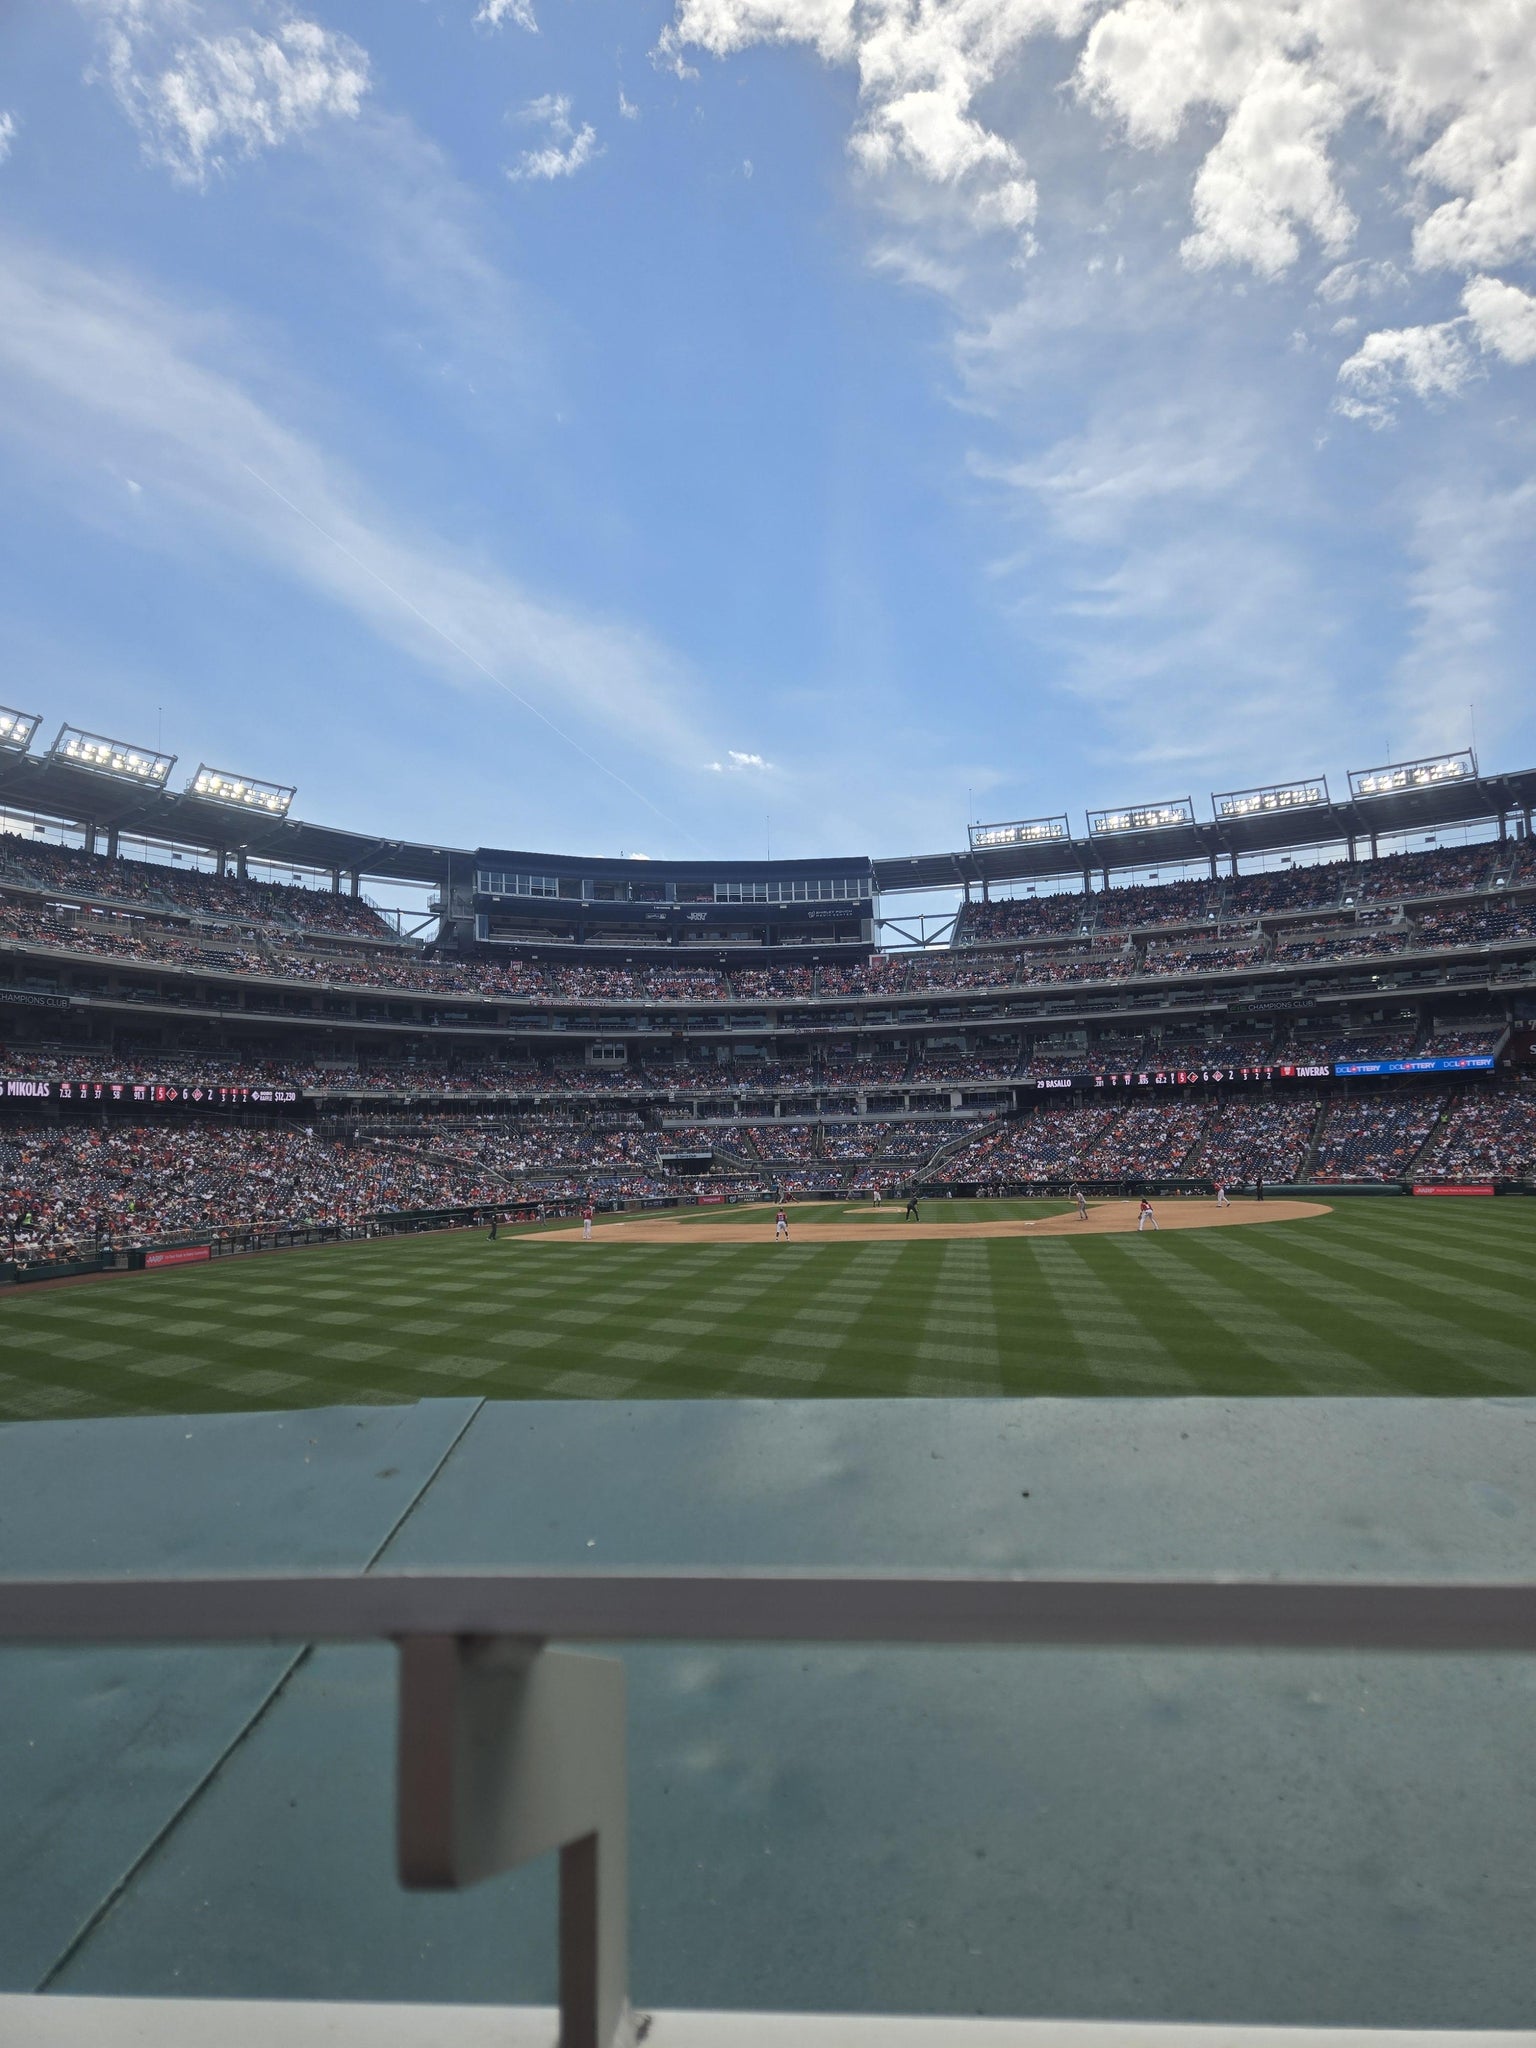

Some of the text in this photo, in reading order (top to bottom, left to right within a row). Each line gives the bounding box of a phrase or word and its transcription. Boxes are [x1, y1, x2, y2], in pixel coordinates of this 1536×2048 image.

[46, 998, 68, 1007] CLUB
[1248, 1001, 1293, 1011] CHAMPIONS
[1293, 999, 1314, 1008] CLUB
[1203, 1071, 1209, 1081] 6
[1228, 1070, 1234, 1080] 2
[1296, 1066, 1329, 1077] TAVERAS
[7, 1081, 50, 1097] MIKOLAS
[1037, 1079, 1072, 1089] 29 BASALLO
[182, 1089, 188, 1100] 6
[207, 1090, 213, 1101] 2
